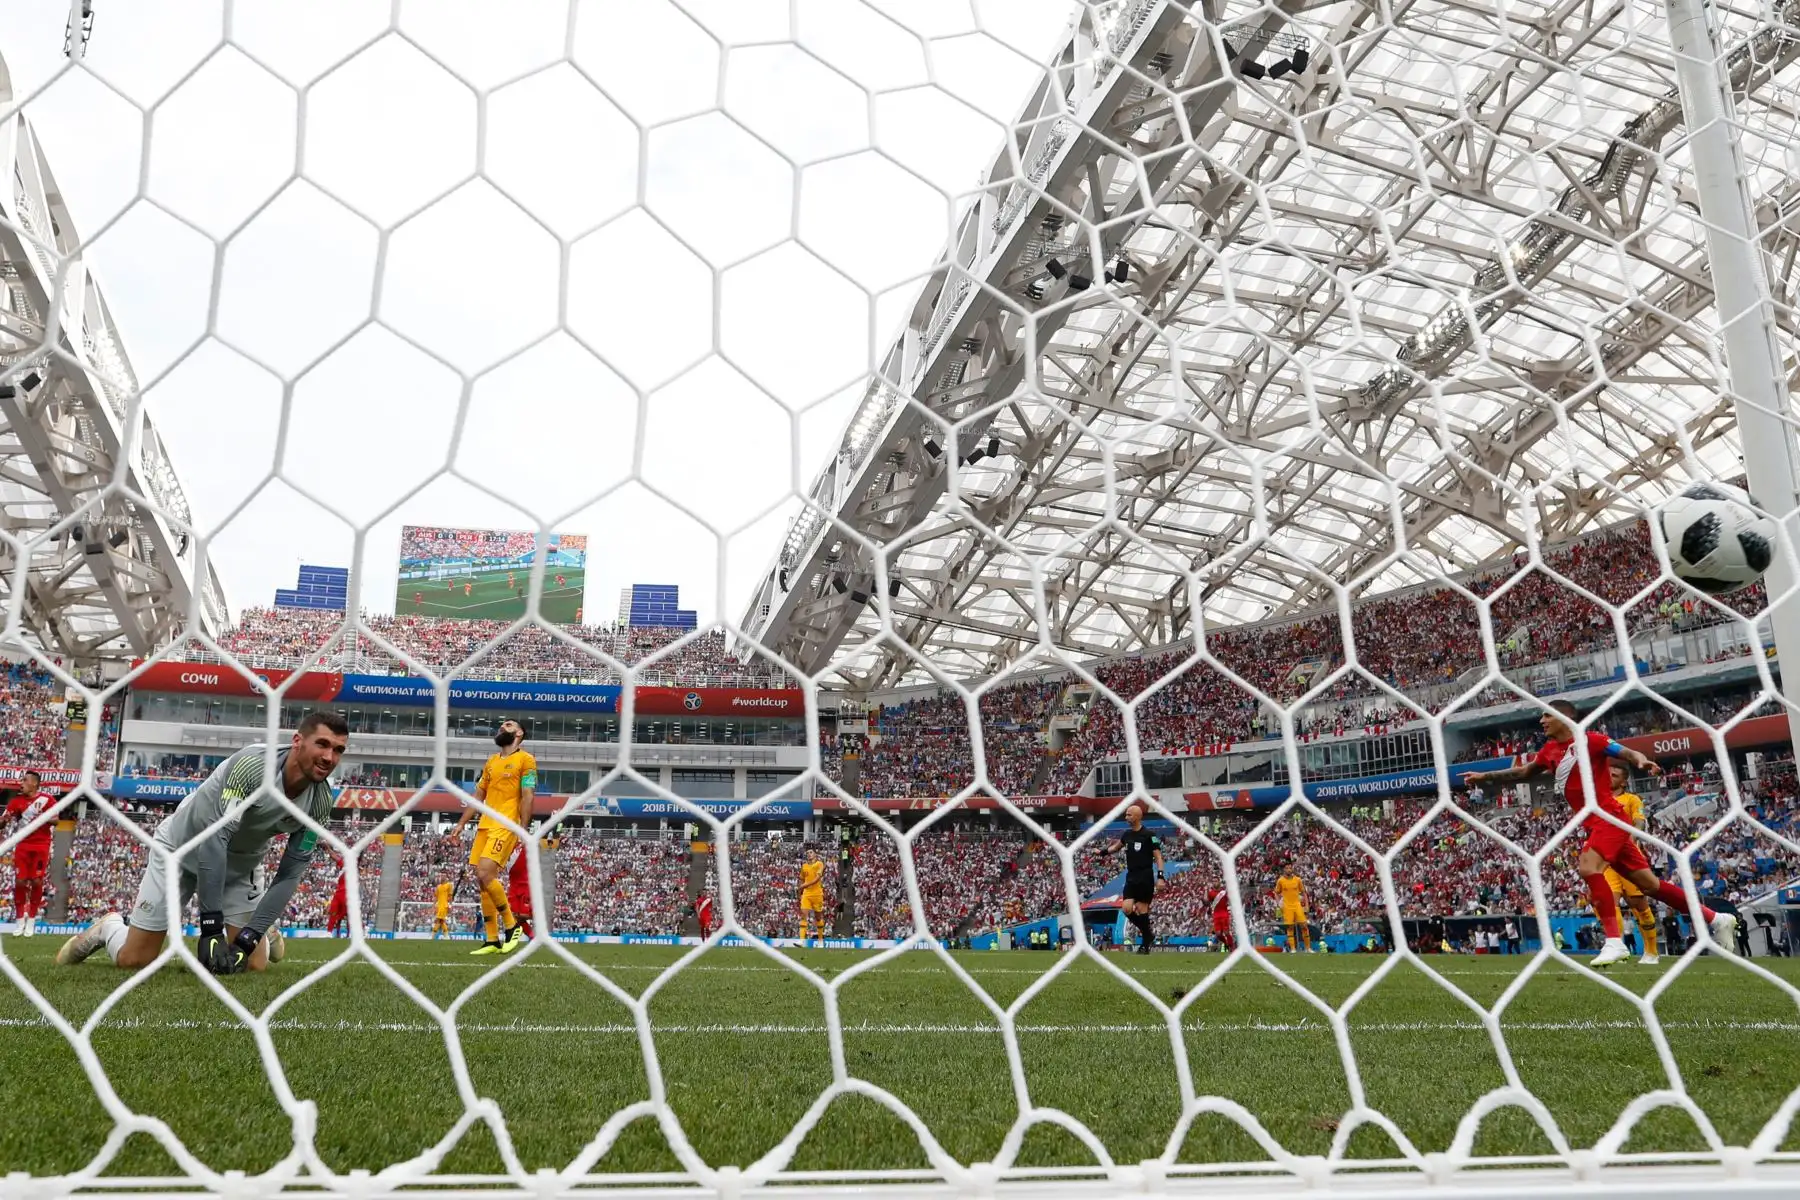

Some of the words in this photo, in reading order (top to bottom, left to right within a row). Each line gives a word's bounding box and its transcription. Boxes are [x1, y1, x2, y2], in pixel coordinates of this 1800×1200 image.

[180, 672, 219, 685] СОЧИ
[353, 684, 414, 696] ЧЕМПИОНАТ
[448, 689, 463, 698] ПО
[464, 690, 510, 700] ФУТБОЛУ
[512, 691, 533, 701] FIFA
[534, 693, 556, 702] 2018
[557, 694, 566, 702] В
[566, 695, 607, 703] РОССИИ
[731, 696, 788, 709] #worldcup
[1653, 736, 1690, 754] SOCHI
[135, 784, 162, 794] 2018
[163, 785, 188, 796] FIFA
[1316, 786, 1338, 797] 2018
[1338, 784, 1358, 795] FIFA
[1359, 780, 1389, 793] WORLD
[1389, 778, 1408, 790] CUP
[642, 803, 666, 813] 2018
[695, 804, 727, 814] ORLD
